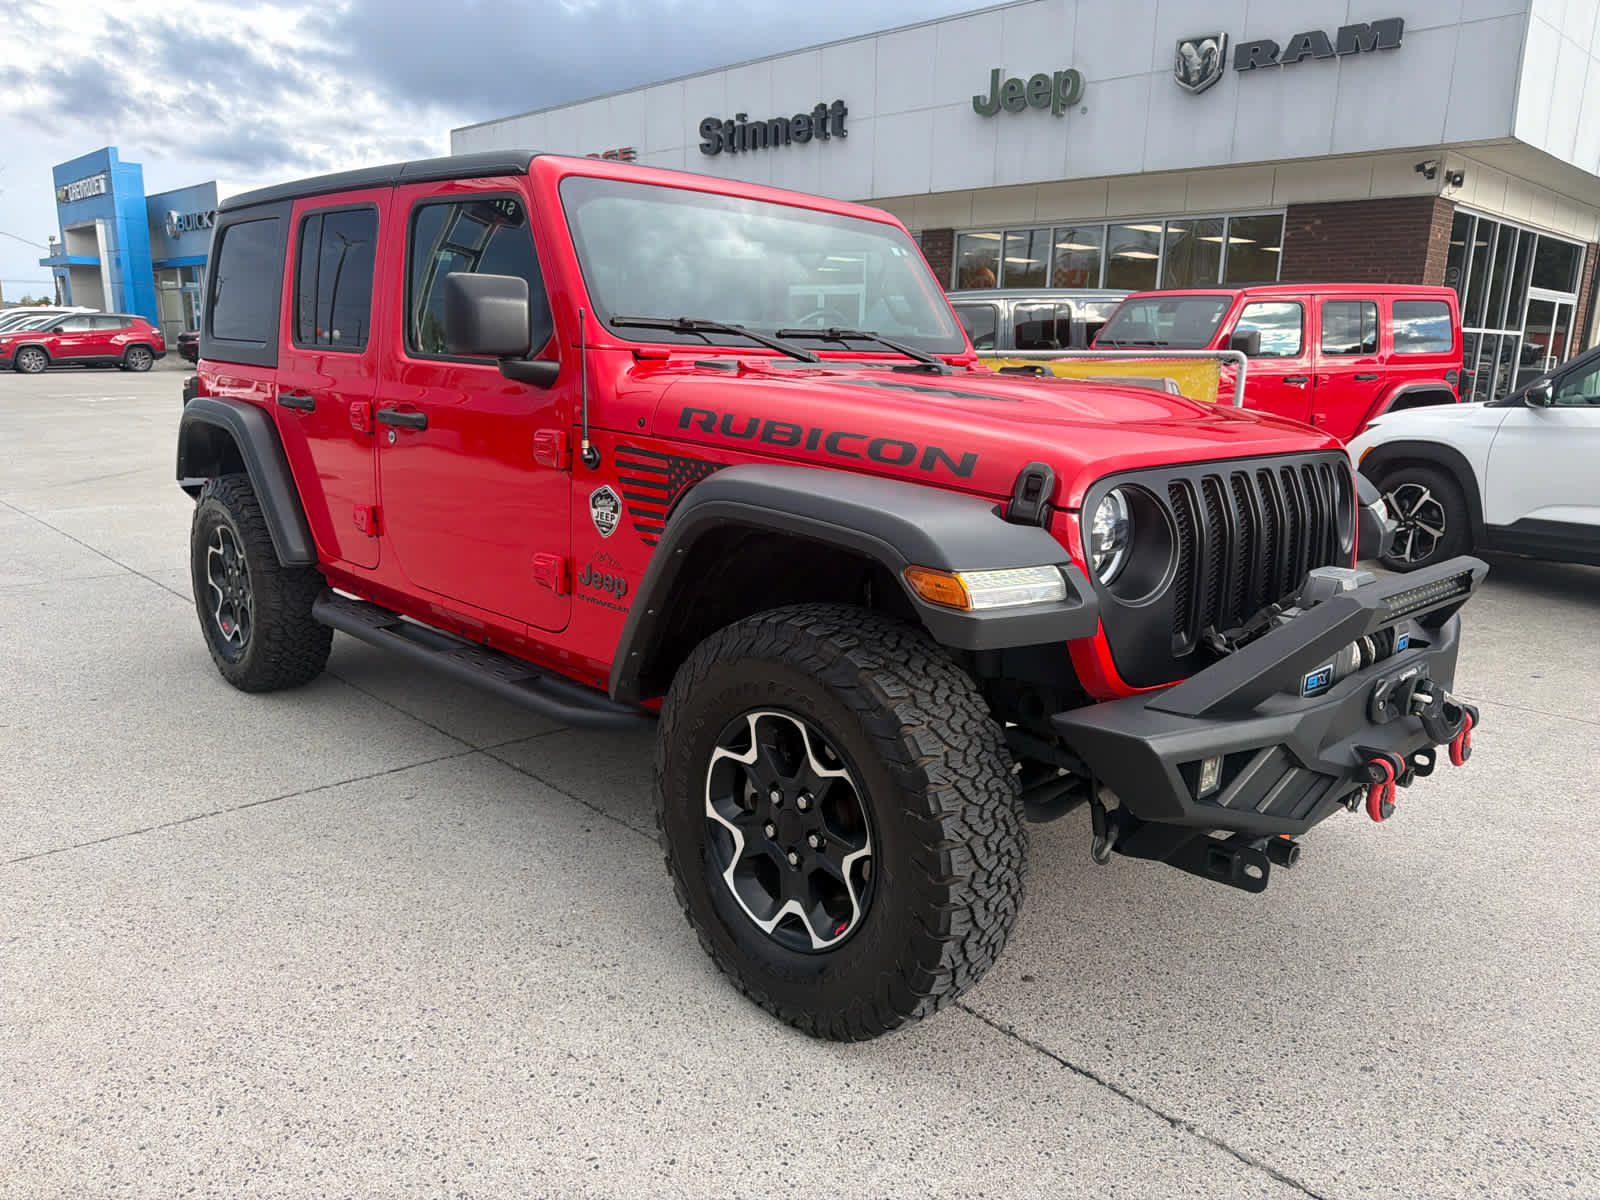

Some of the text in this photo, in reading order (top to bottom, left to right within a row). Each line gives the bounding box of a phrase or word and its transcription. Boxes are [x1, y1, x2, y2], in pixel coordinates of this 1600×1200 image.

[1232, 17, 1405, 72] RAM
[972, 67, 1086, 119] Jeep
[699, 99, 848, 156] Stinnett
[68, 174, 106, 202] CHEVROLET
[176, 209, 217, 233] BUICK
[677, 406, 980, 479] RUBICON
[595, 510, 616, 522] JEEP
[578, 562, 628, 600] Jeep
